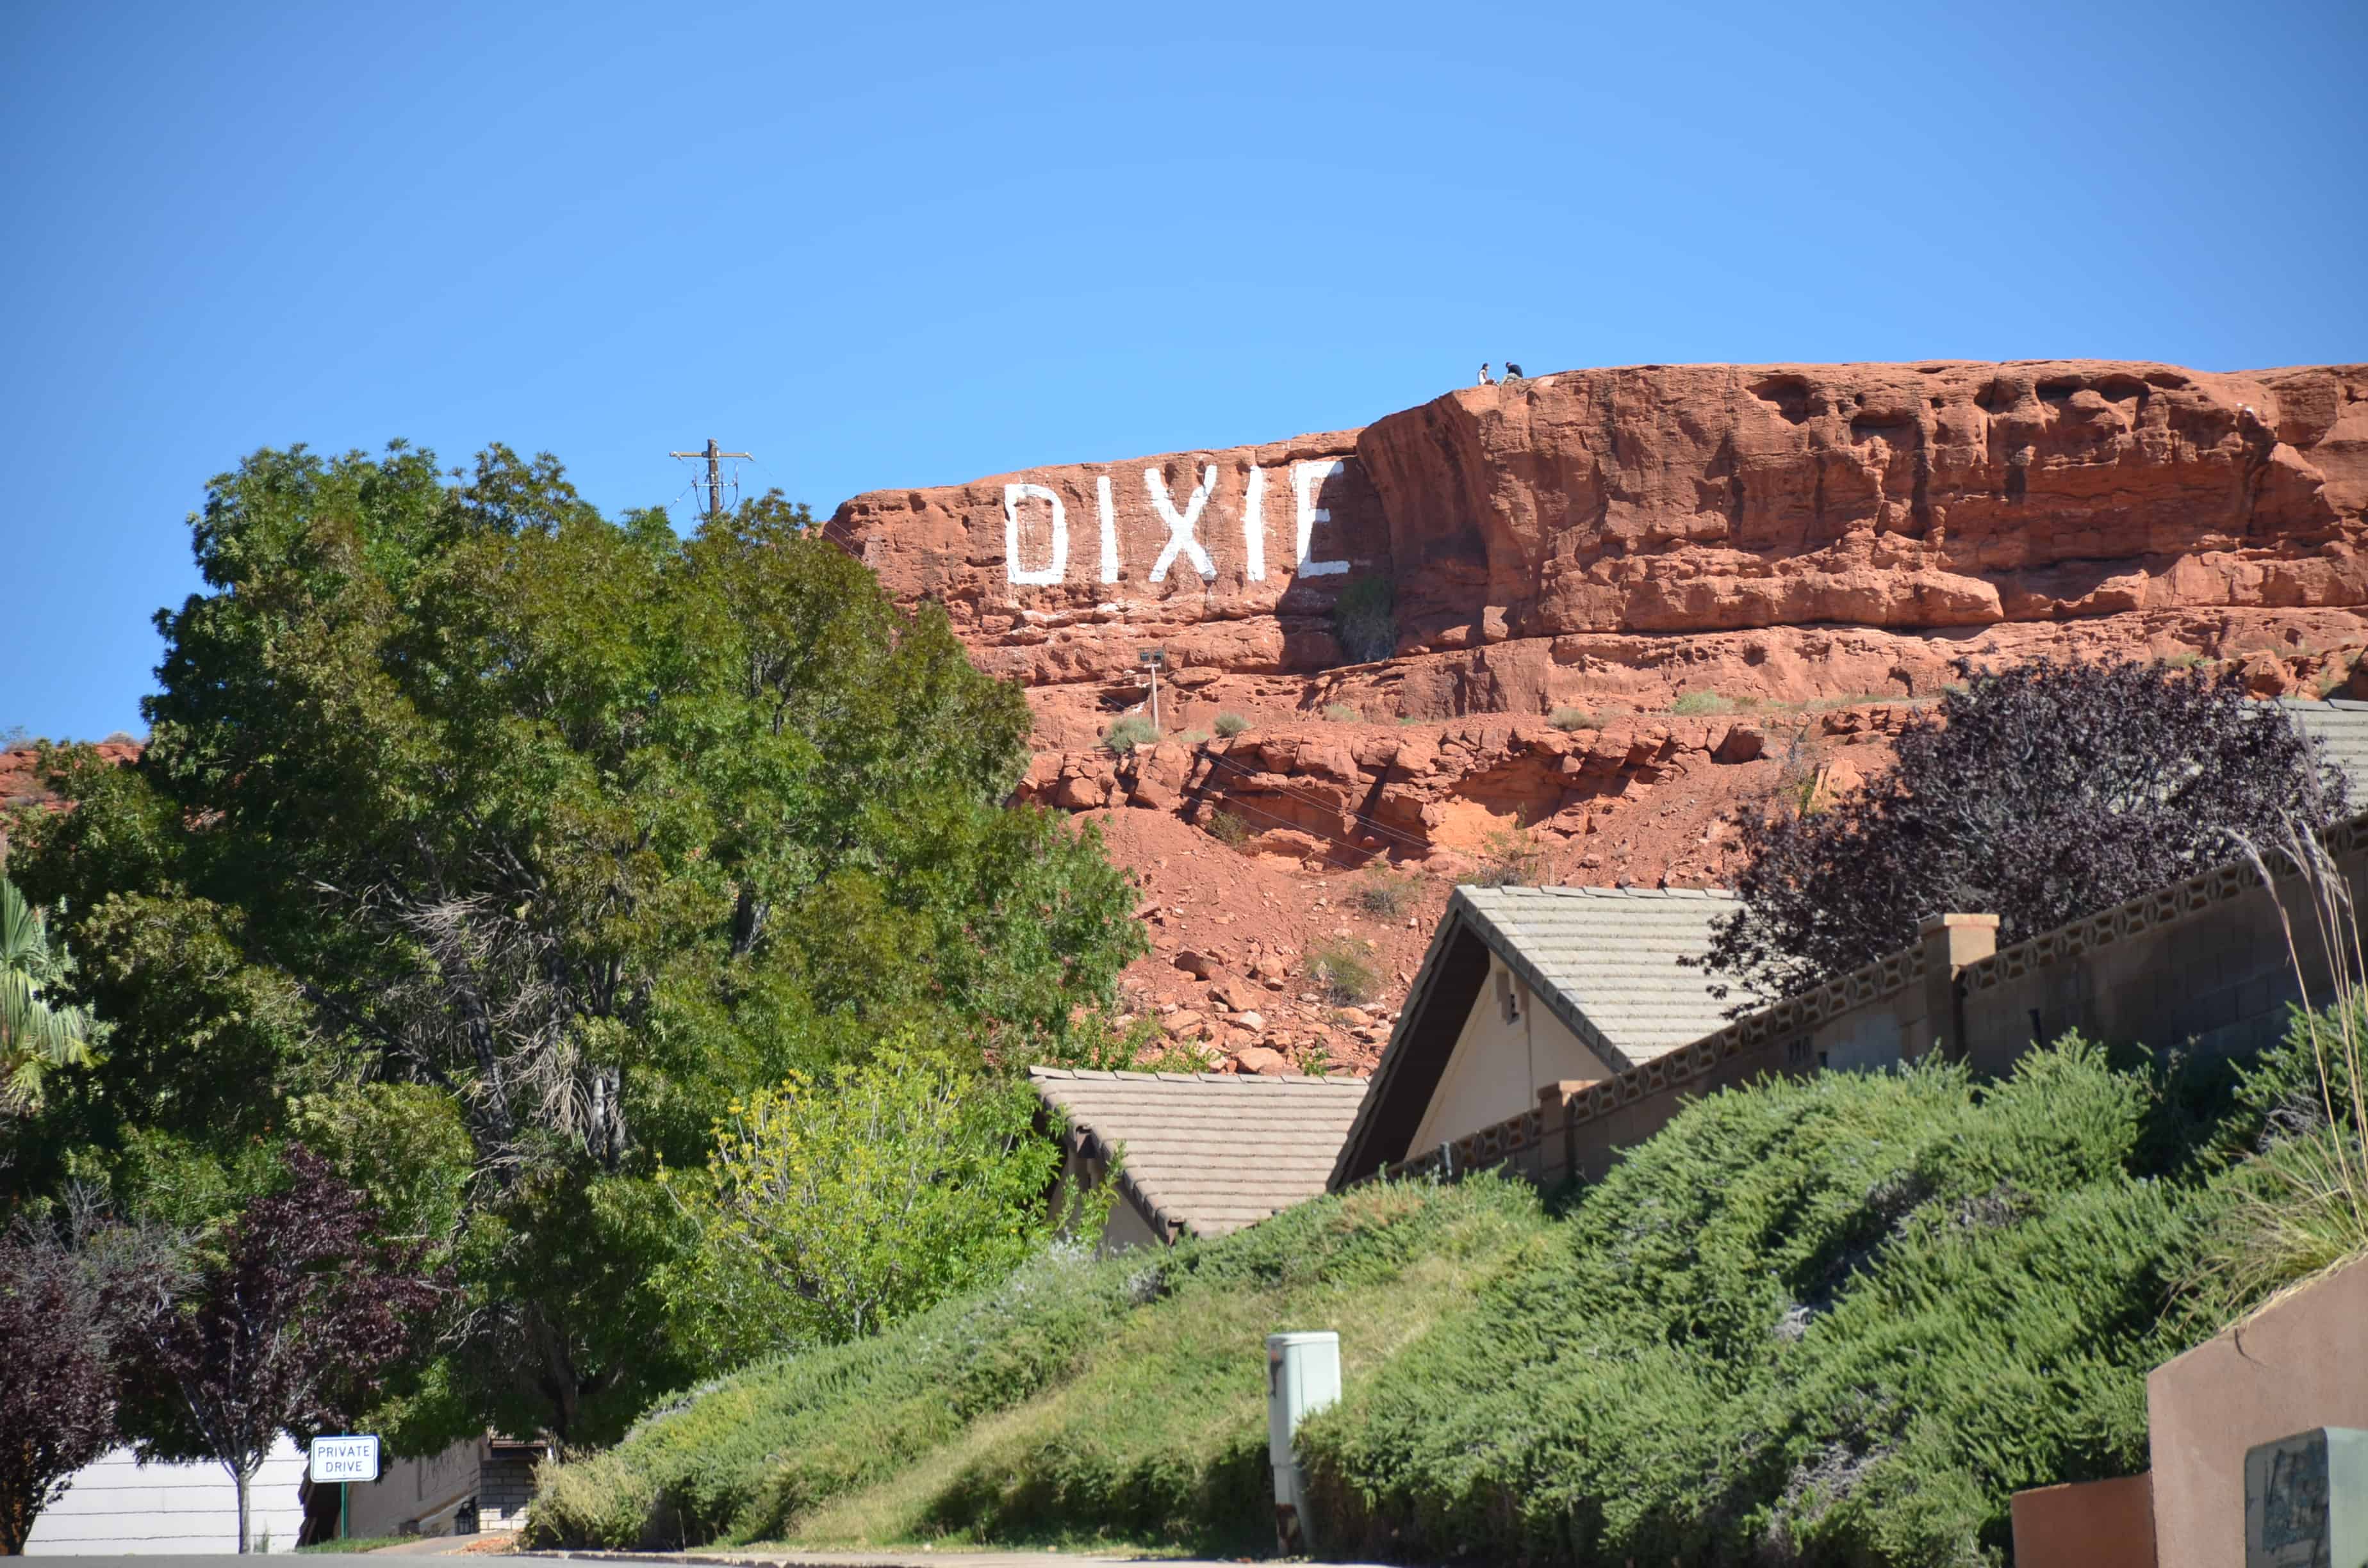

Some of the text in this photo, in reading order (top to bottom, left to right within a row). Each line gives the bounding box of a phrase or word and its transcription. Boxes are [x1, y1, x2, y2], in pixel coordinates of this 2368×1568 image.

[1005, 460, 1351, 585] DIXIE
[318, 1446, 370, 1457] PRIVATE
[325, 1461, 362, 1472] DRIVE
